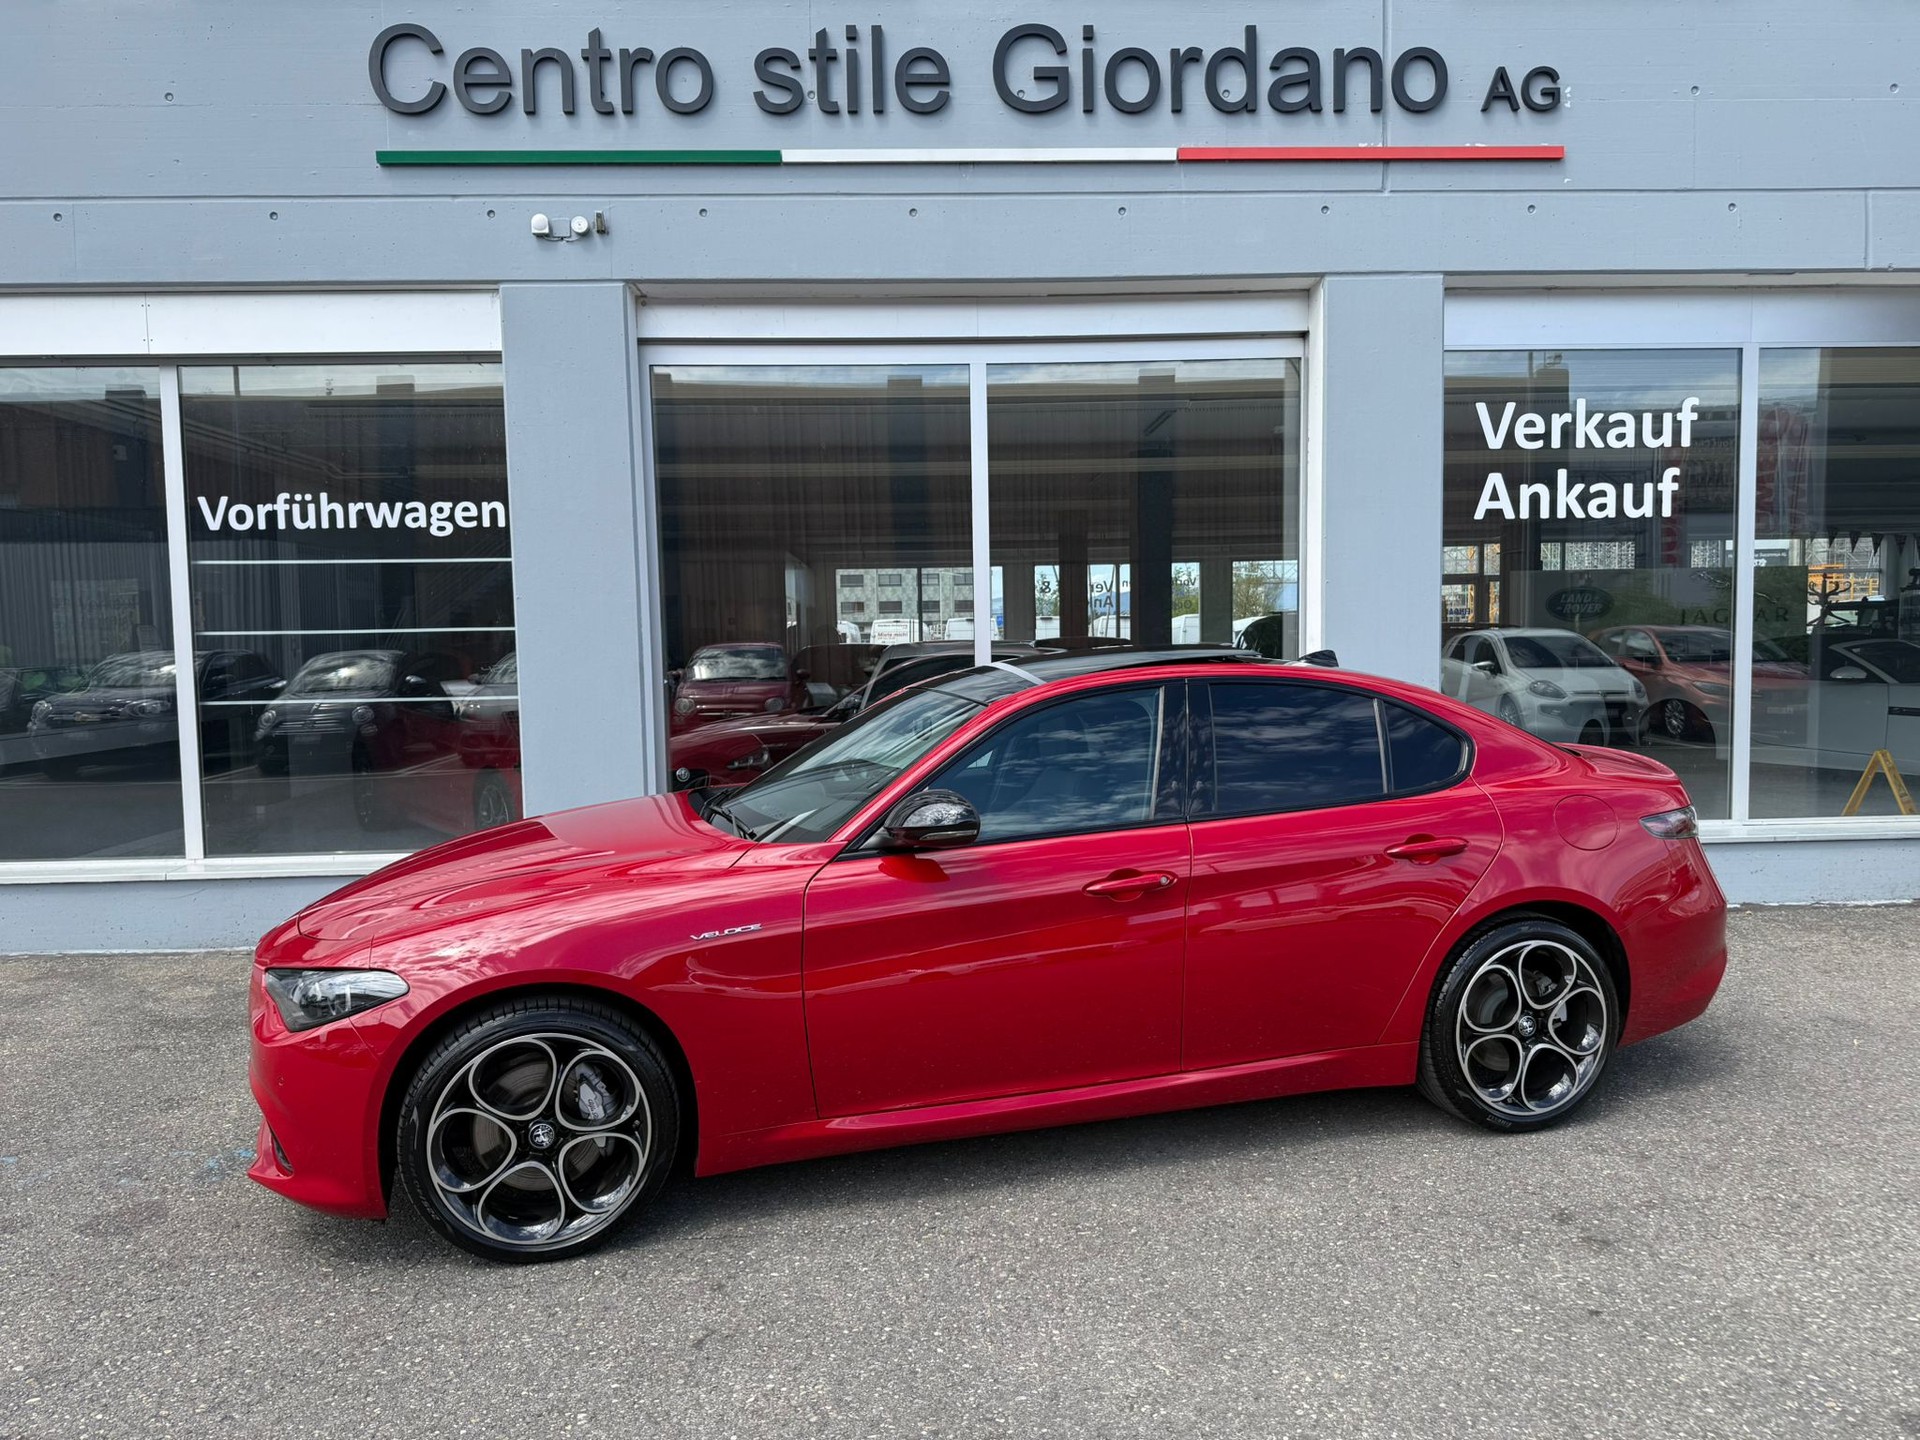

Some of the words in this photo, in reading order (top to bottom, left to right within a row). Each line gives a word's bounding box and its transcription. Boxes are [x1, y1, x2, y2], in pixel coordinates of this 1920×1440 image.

[368, 23, 716, 119] Centro
[753, 24, 952, 118] stile
[992, 23, 1449, 118] Giordano
[1480, 66, 1562, 115] AG
[1475, 396, 1700, 450] Verkauf
[1473, 467, 1681, 520] Ankauf
[197, 492, 507, 537] Vorführwagen
[1560, 593, 1592, 603] LAND
[1562, 602, 1603, 613] ROVER
[1679, 606, 1790, 625] JAGAR
[690, 922, 763, 941] VELOCE
